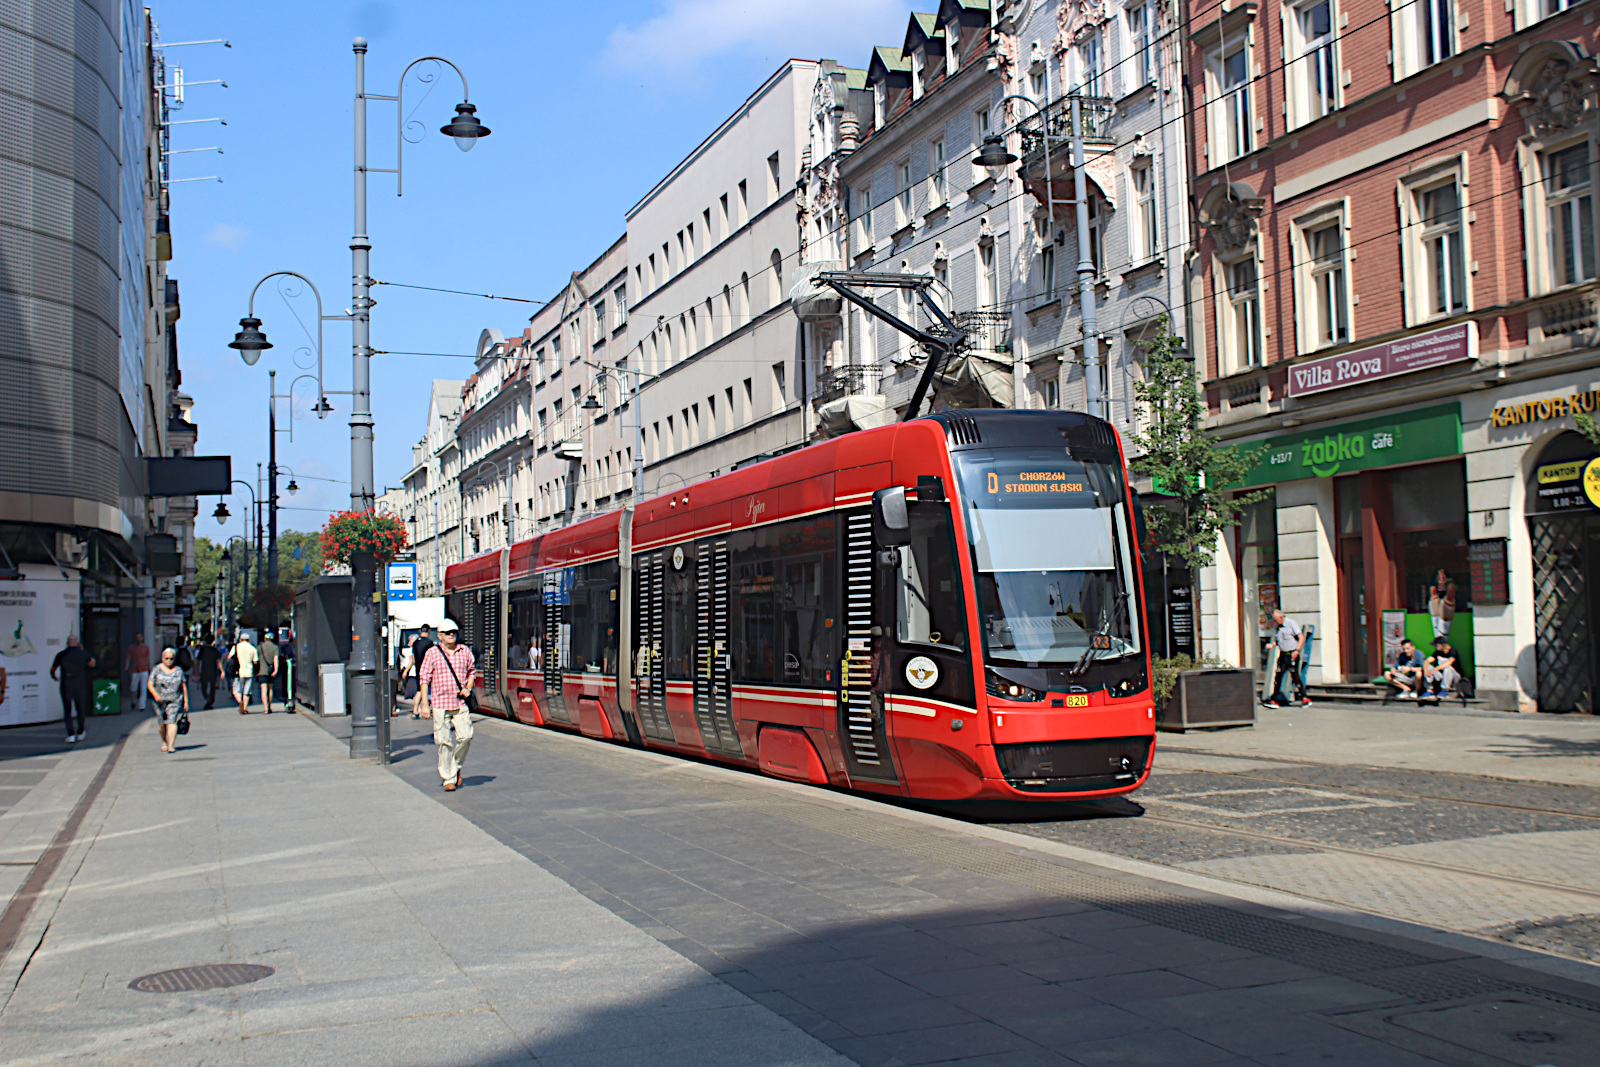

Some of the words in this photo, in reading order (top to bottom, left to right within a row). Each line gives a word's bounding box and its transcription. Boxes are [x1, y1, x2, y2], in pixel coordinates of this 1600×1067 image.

[1294, 365, 1332, 389] Villa
[1336, 358, 1381, 380] Nova
[1371, 433, 1394, 449] café
[1301, 433, 1364, 467] żabka
[1543, 467, 1577, 478] KANTOR
[988, 472, 998, 493] D
[1005, 483, 1047, 493] STADION
[1049, 483, 1082, 493] ŚLĄSKI
[1483, 511, 1494, 528] 15
[1067, 696, 1086, 706] 820
